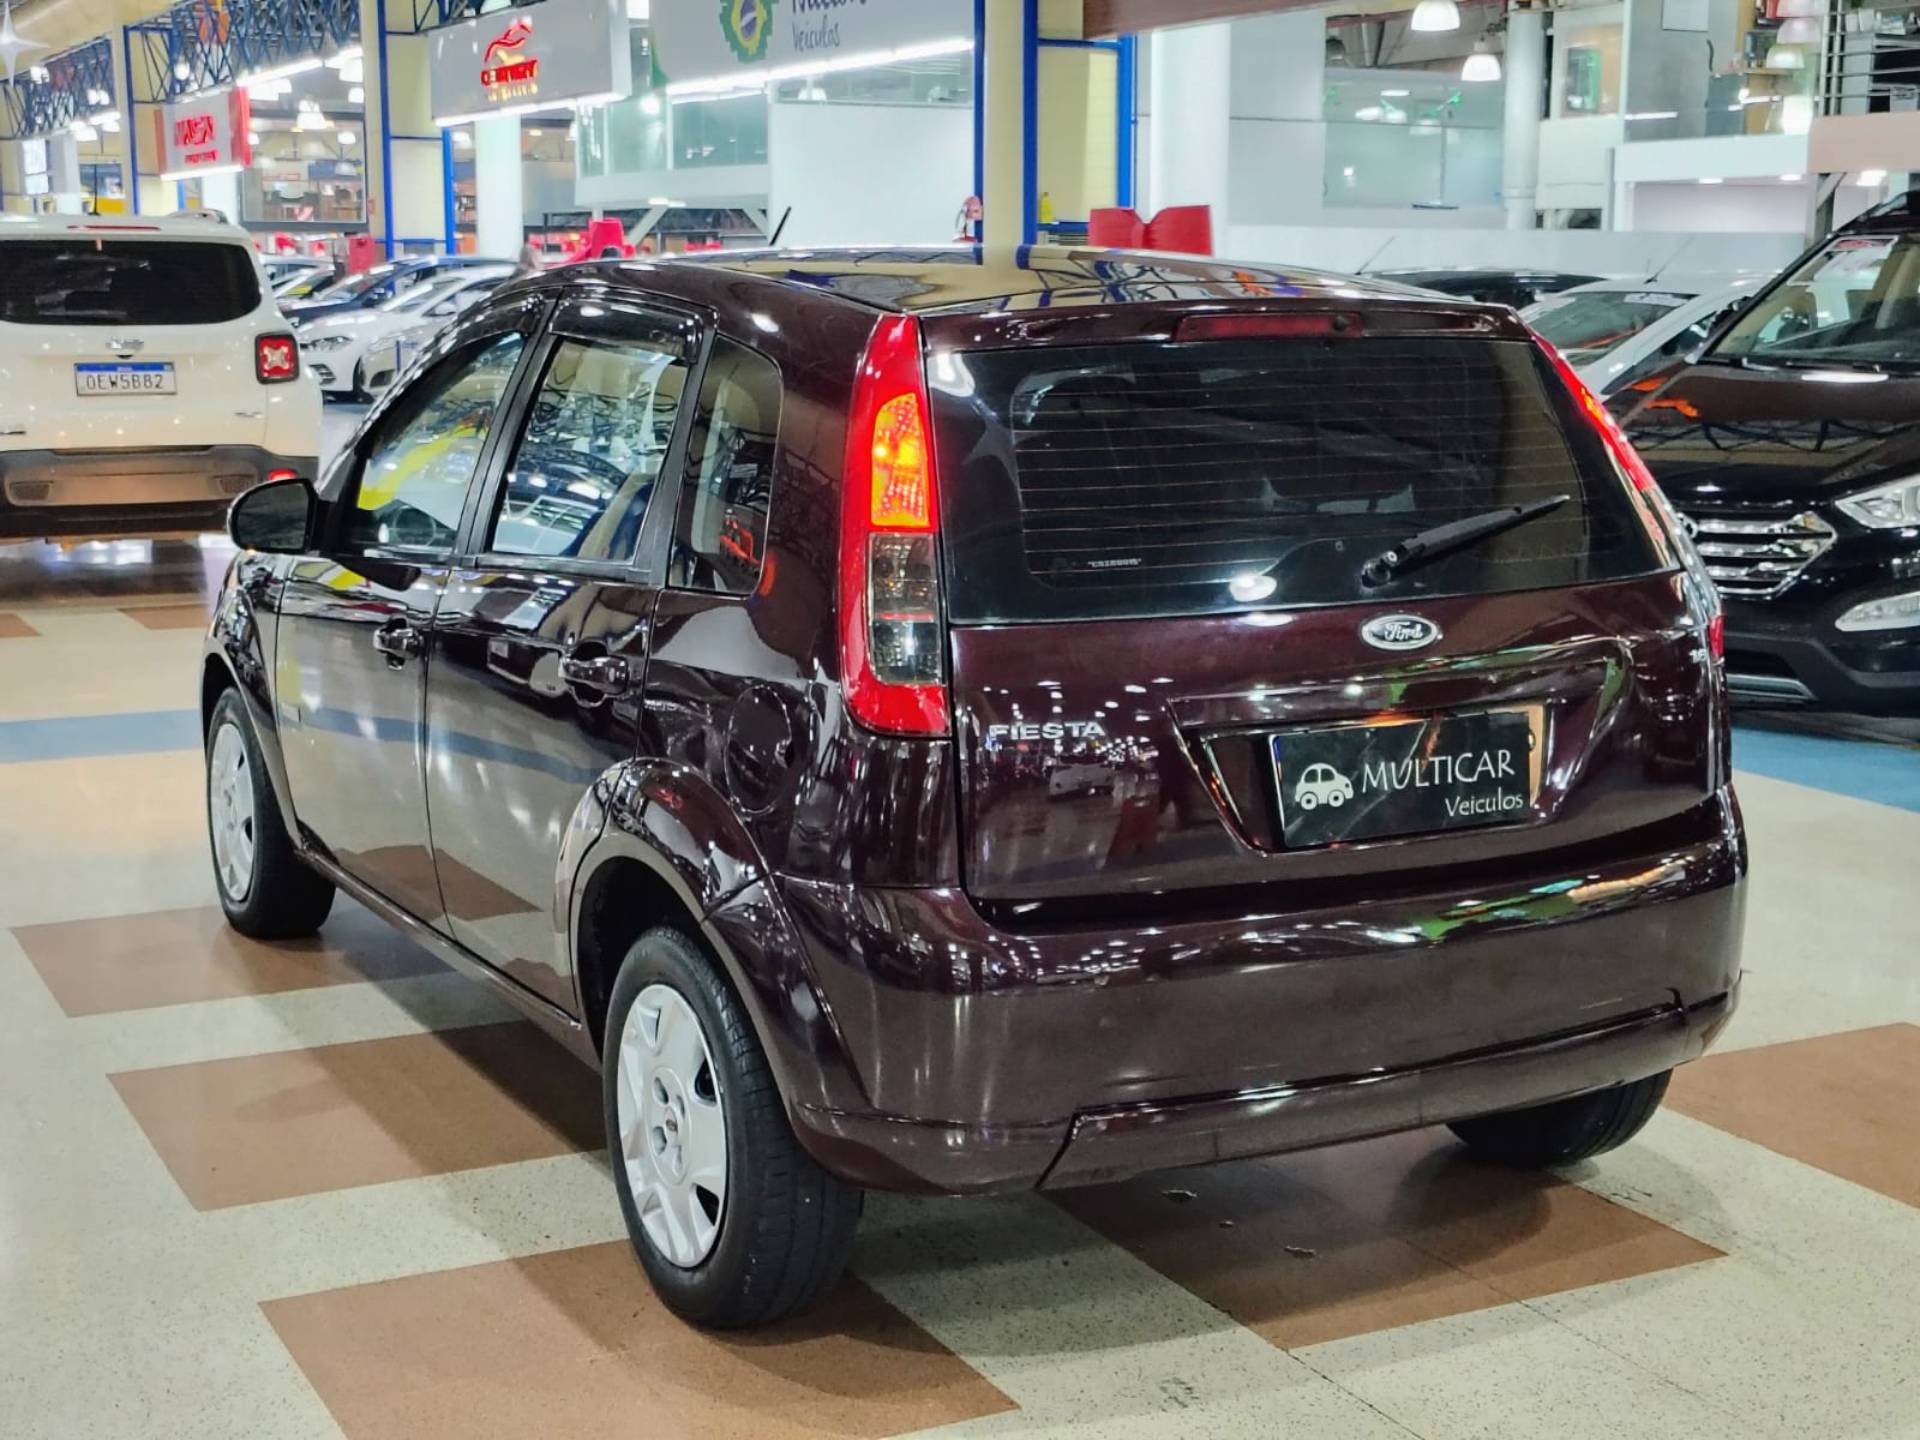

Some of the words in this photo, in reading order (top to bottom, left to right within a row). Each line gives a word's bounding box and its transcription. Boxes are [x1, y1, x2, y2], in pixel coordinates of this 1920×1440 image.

[1384, 621, 1423, 641] Ford
[988, 721, 1106, 741] FIESTA
[1362, 749, 1515, 794] MULTICAR
